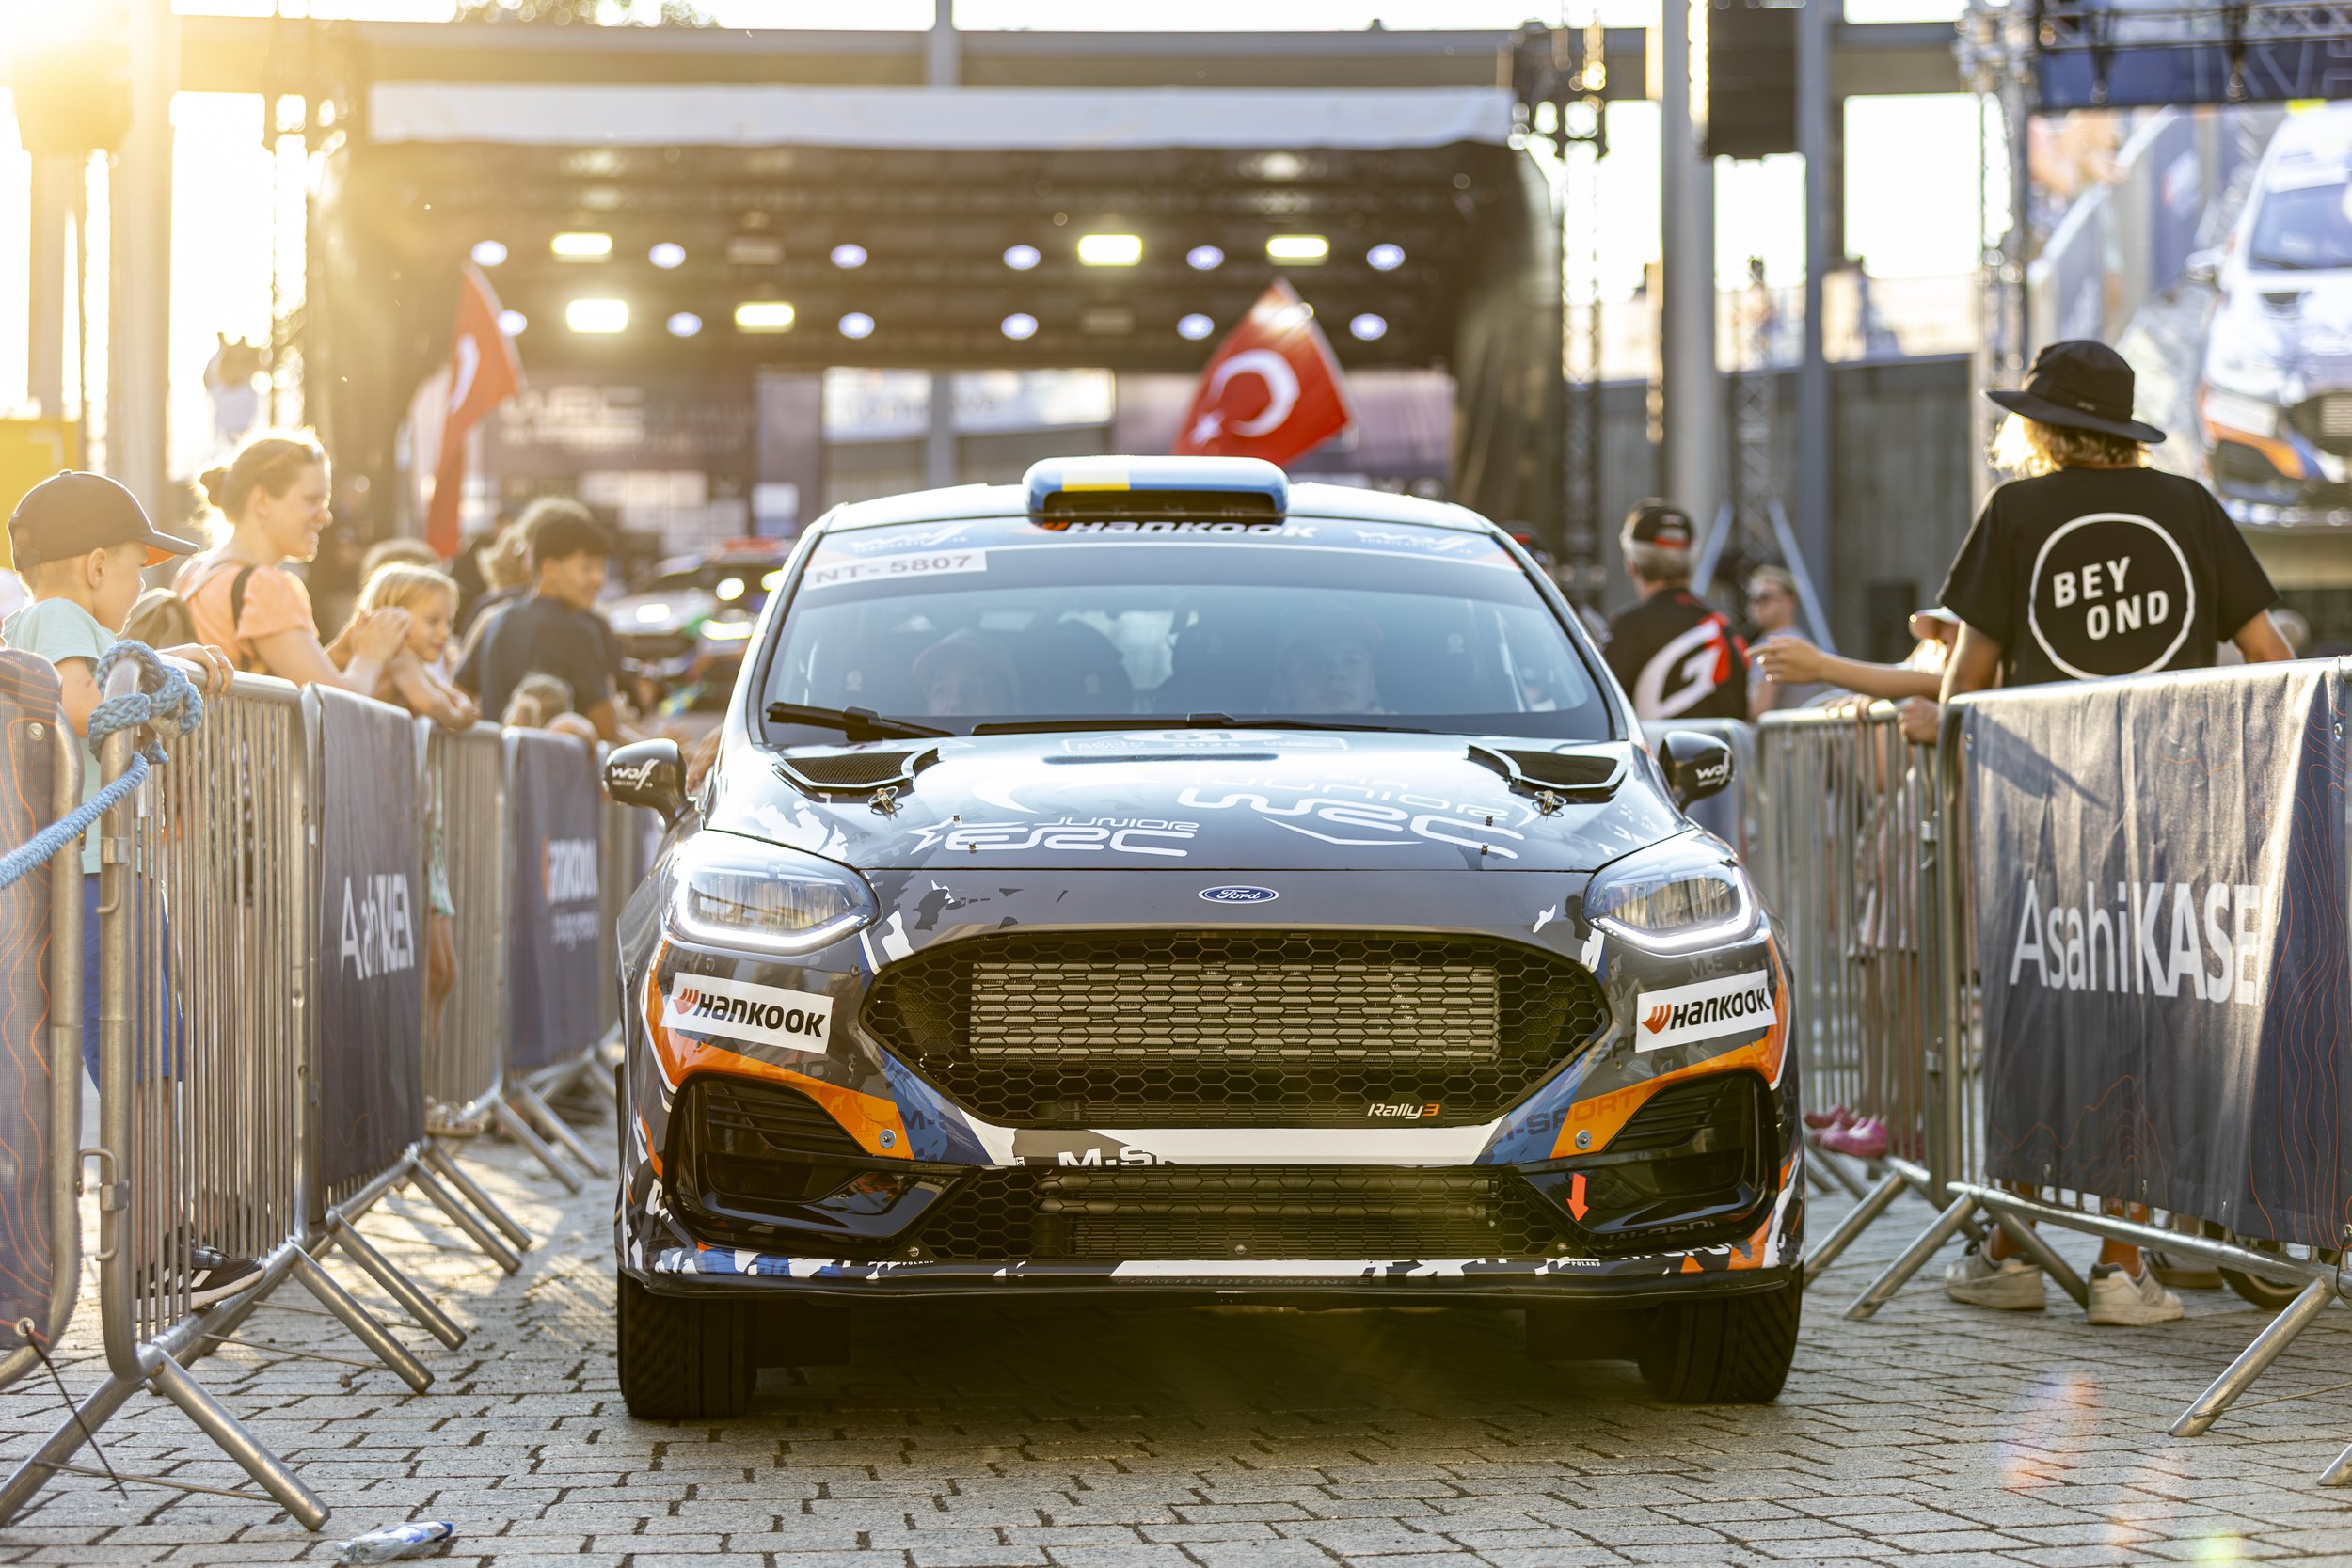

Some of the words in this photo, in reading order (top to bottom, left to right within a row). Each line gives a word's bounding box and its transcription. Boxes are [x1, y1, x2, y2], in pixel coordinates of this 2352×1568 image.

[2053, 556, 2131, 609] BEY
[2086, 590, 2169, 641] OND
[1216, 889, 1262, 900] Ford
[1367, 1103, 1441, 1119] Rally3
